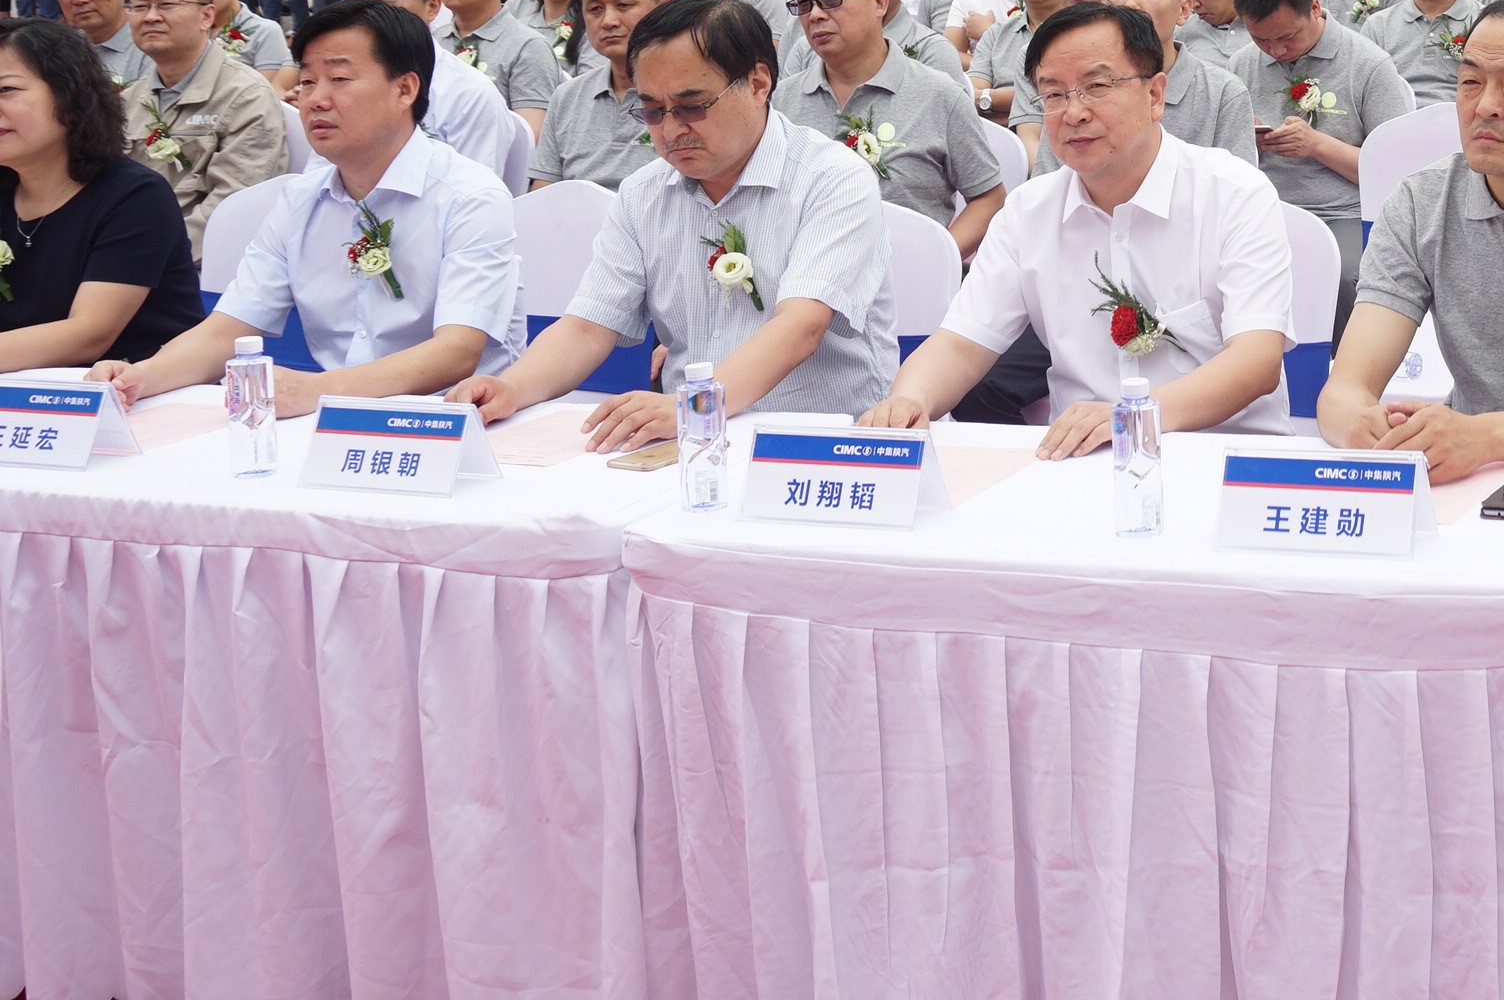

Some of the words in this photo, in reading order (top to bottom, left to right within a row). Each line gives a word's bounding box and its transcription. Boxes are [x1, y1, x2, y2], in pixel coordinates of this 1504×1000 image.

[29, 394, 53, 405] CIMC
[63, 396, 91, 406] 中集陕汽
[387, 417, 413, 428] CIMC
[424, 420, 453, 431] 中集陕汽
[833, 444, 862, 456] CIMC
[876, 446, 909, 457] 中集陕汽
[340, 448, 422, 478] 周银朝
[1314, 467, 1347, 480] CIMC
[1364, 470, 1402, 482] 中集陕汽
[784, 478, 876, 511] 刘翔韬
[1263, 505, 1365, 537] 王建勋
